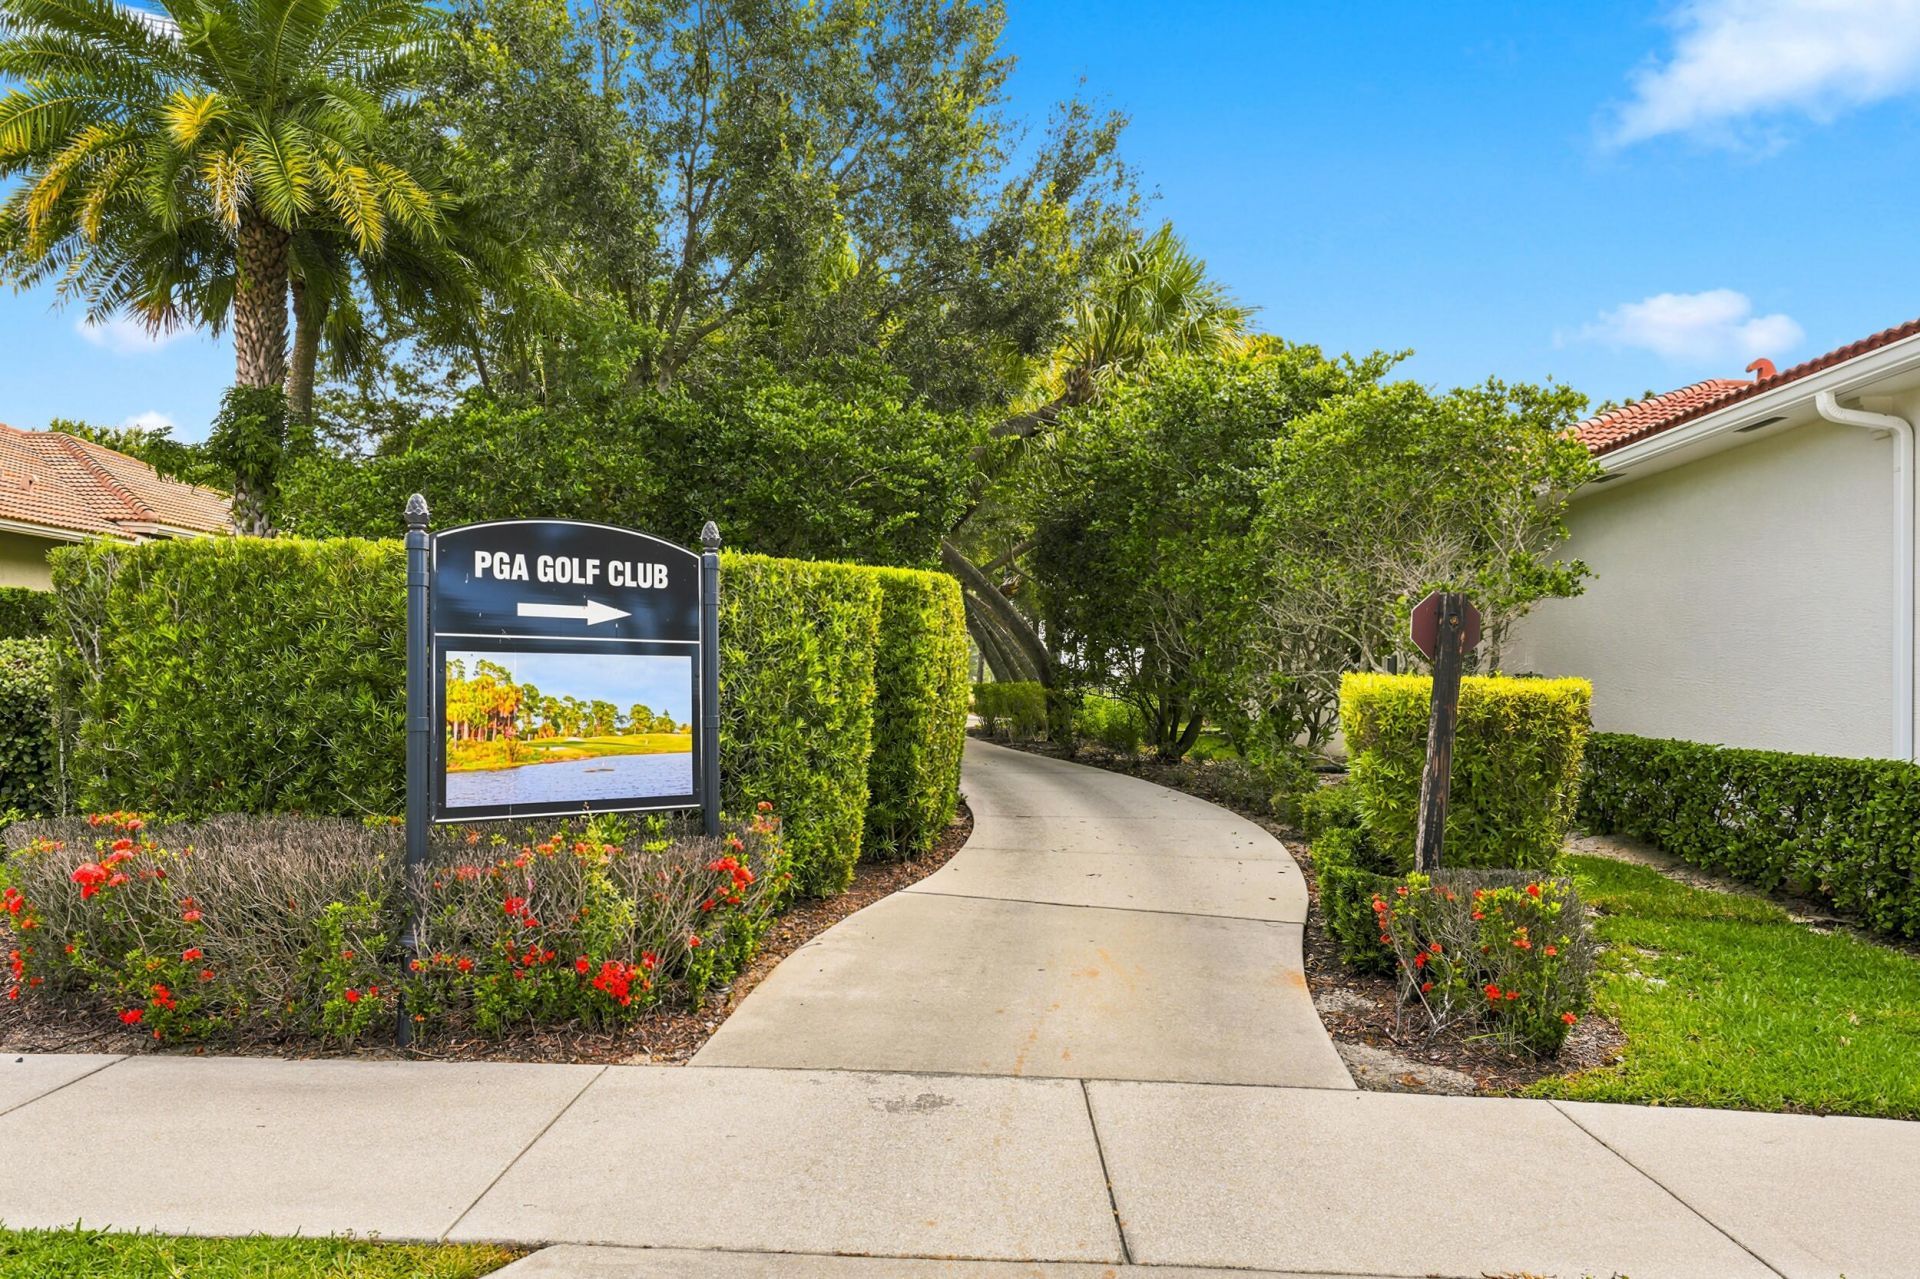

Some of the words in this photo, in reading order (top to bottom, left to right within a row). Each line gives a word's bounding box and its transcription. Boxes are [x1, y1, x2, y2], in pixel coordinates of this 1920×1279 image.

[474, 550, 530, 581] PGA
[536, 555, 601, 585] GOLF
[608, 560, 669, 589] CLUB
